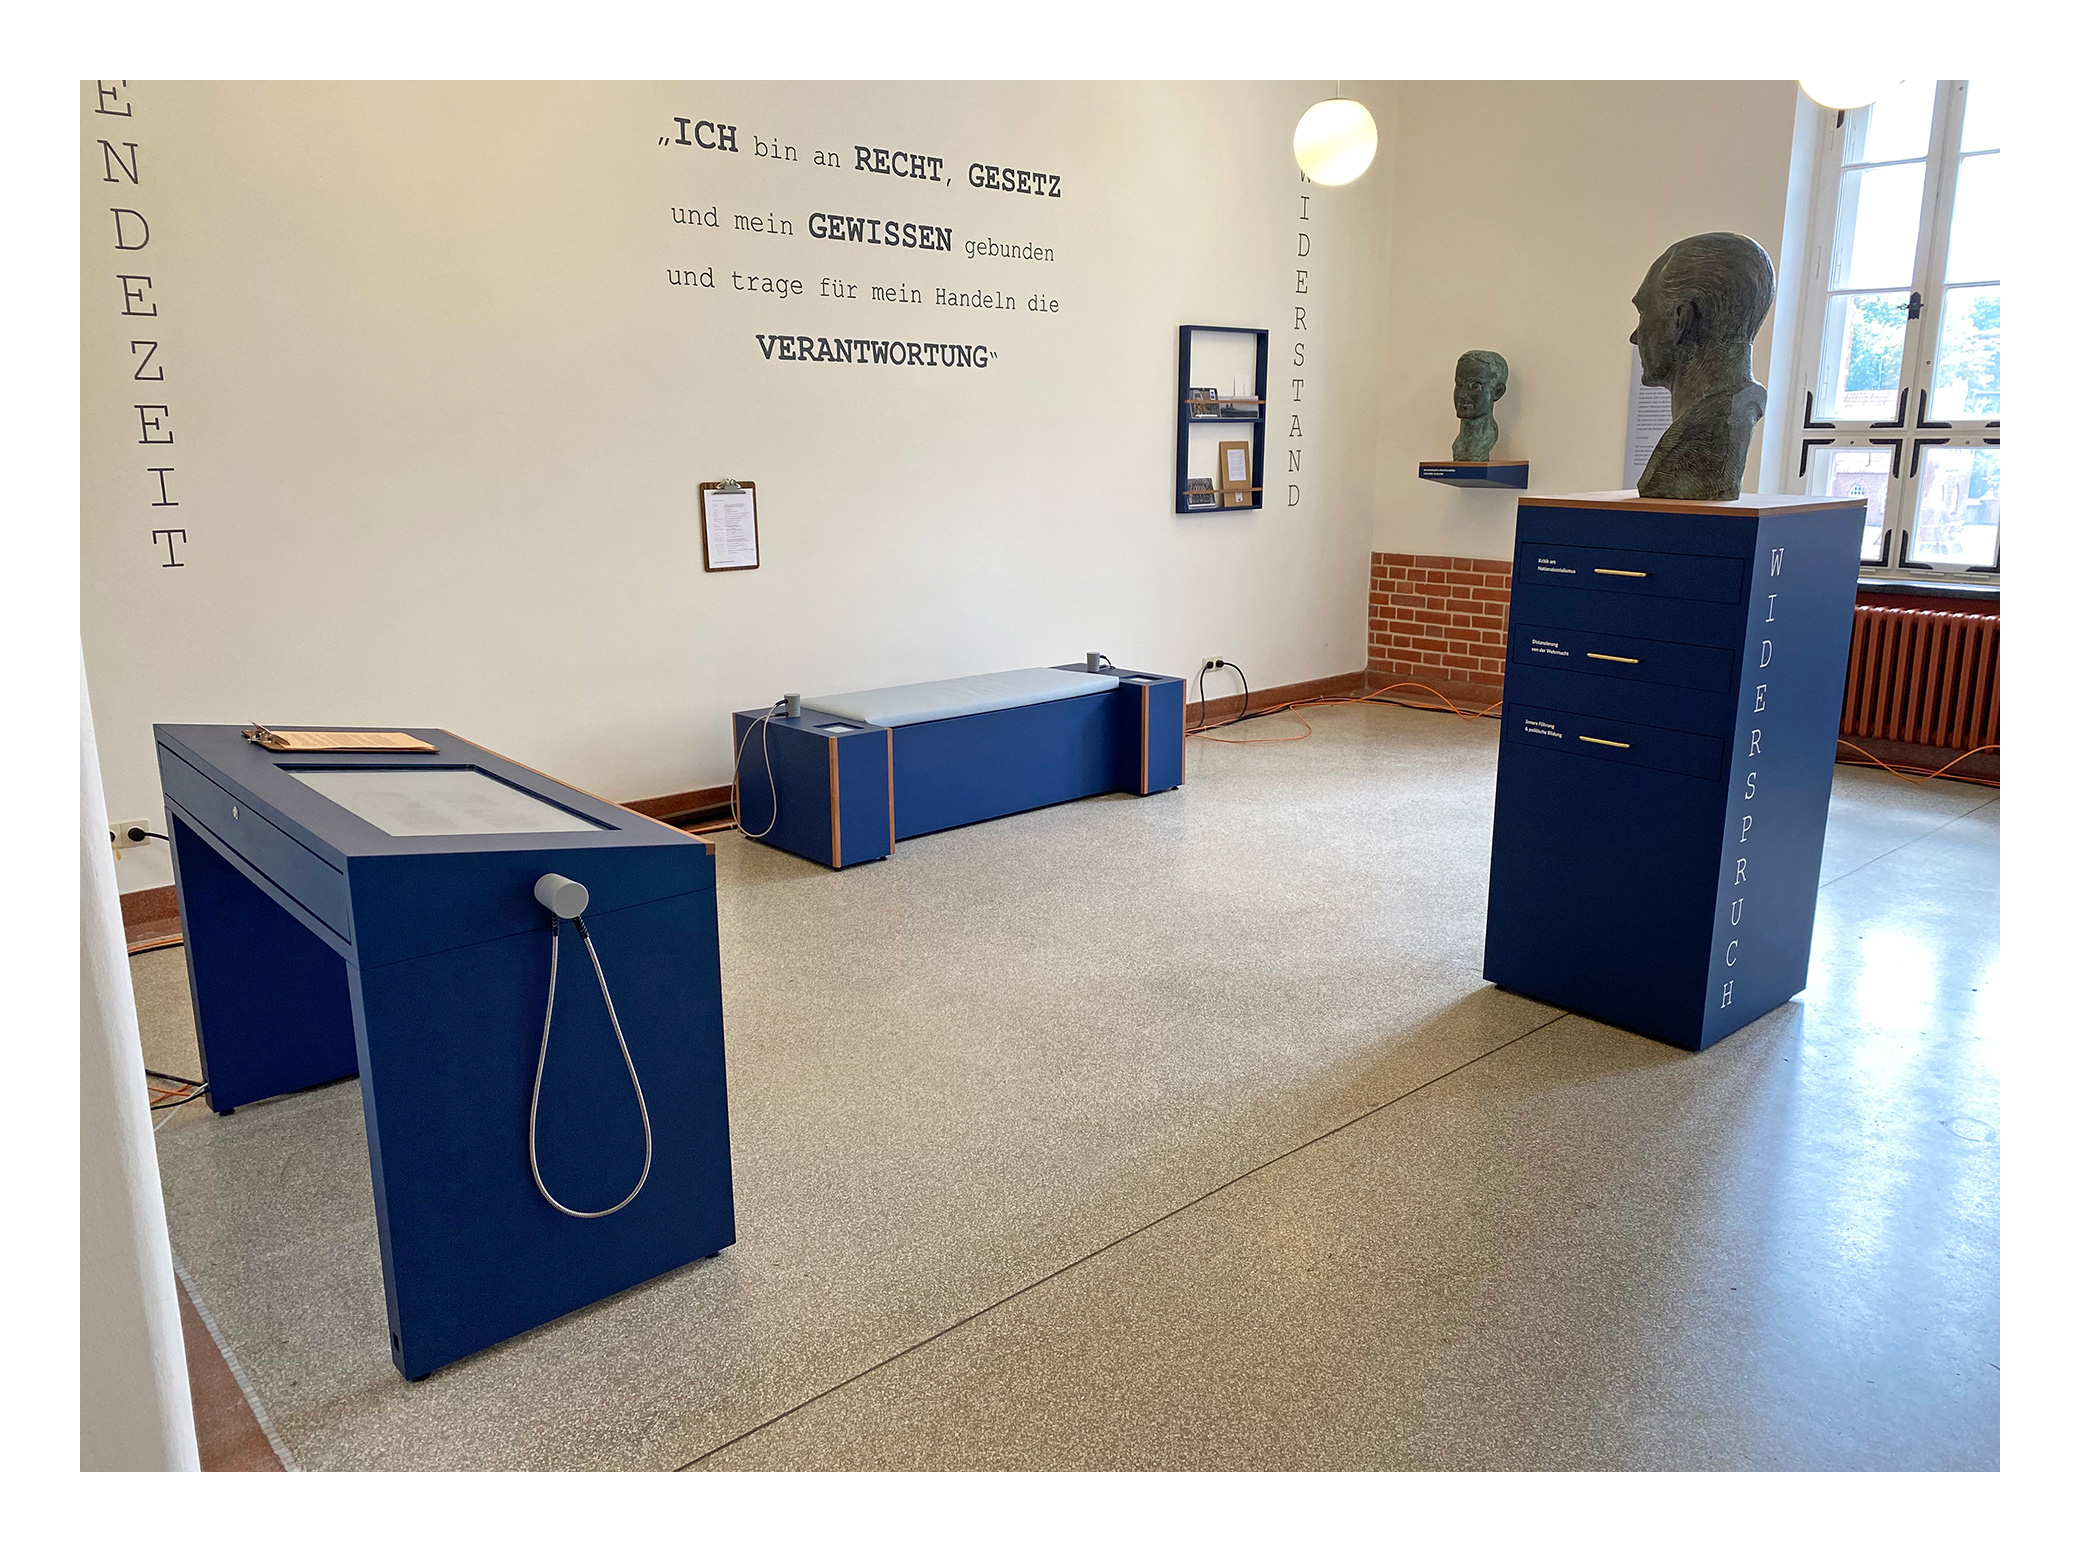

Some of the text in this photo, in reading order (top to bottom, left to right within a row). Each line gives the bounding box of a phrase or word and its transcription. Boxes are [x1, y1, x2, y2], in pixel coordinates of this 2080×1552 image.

[753, 136, 798, 162] bin
[813, 150, 841, 168] an
[854, 145, 952, 188] RECHT,
[968, 163, 1062, 199] GESETZ
[670, 206, 1055, 262] und mein GEWISSEN gebunden
[666, 266, 1060, 313] und trage für mein Handeln die
[1720, 548, 1784, 1009] WIDERSPRUCH
